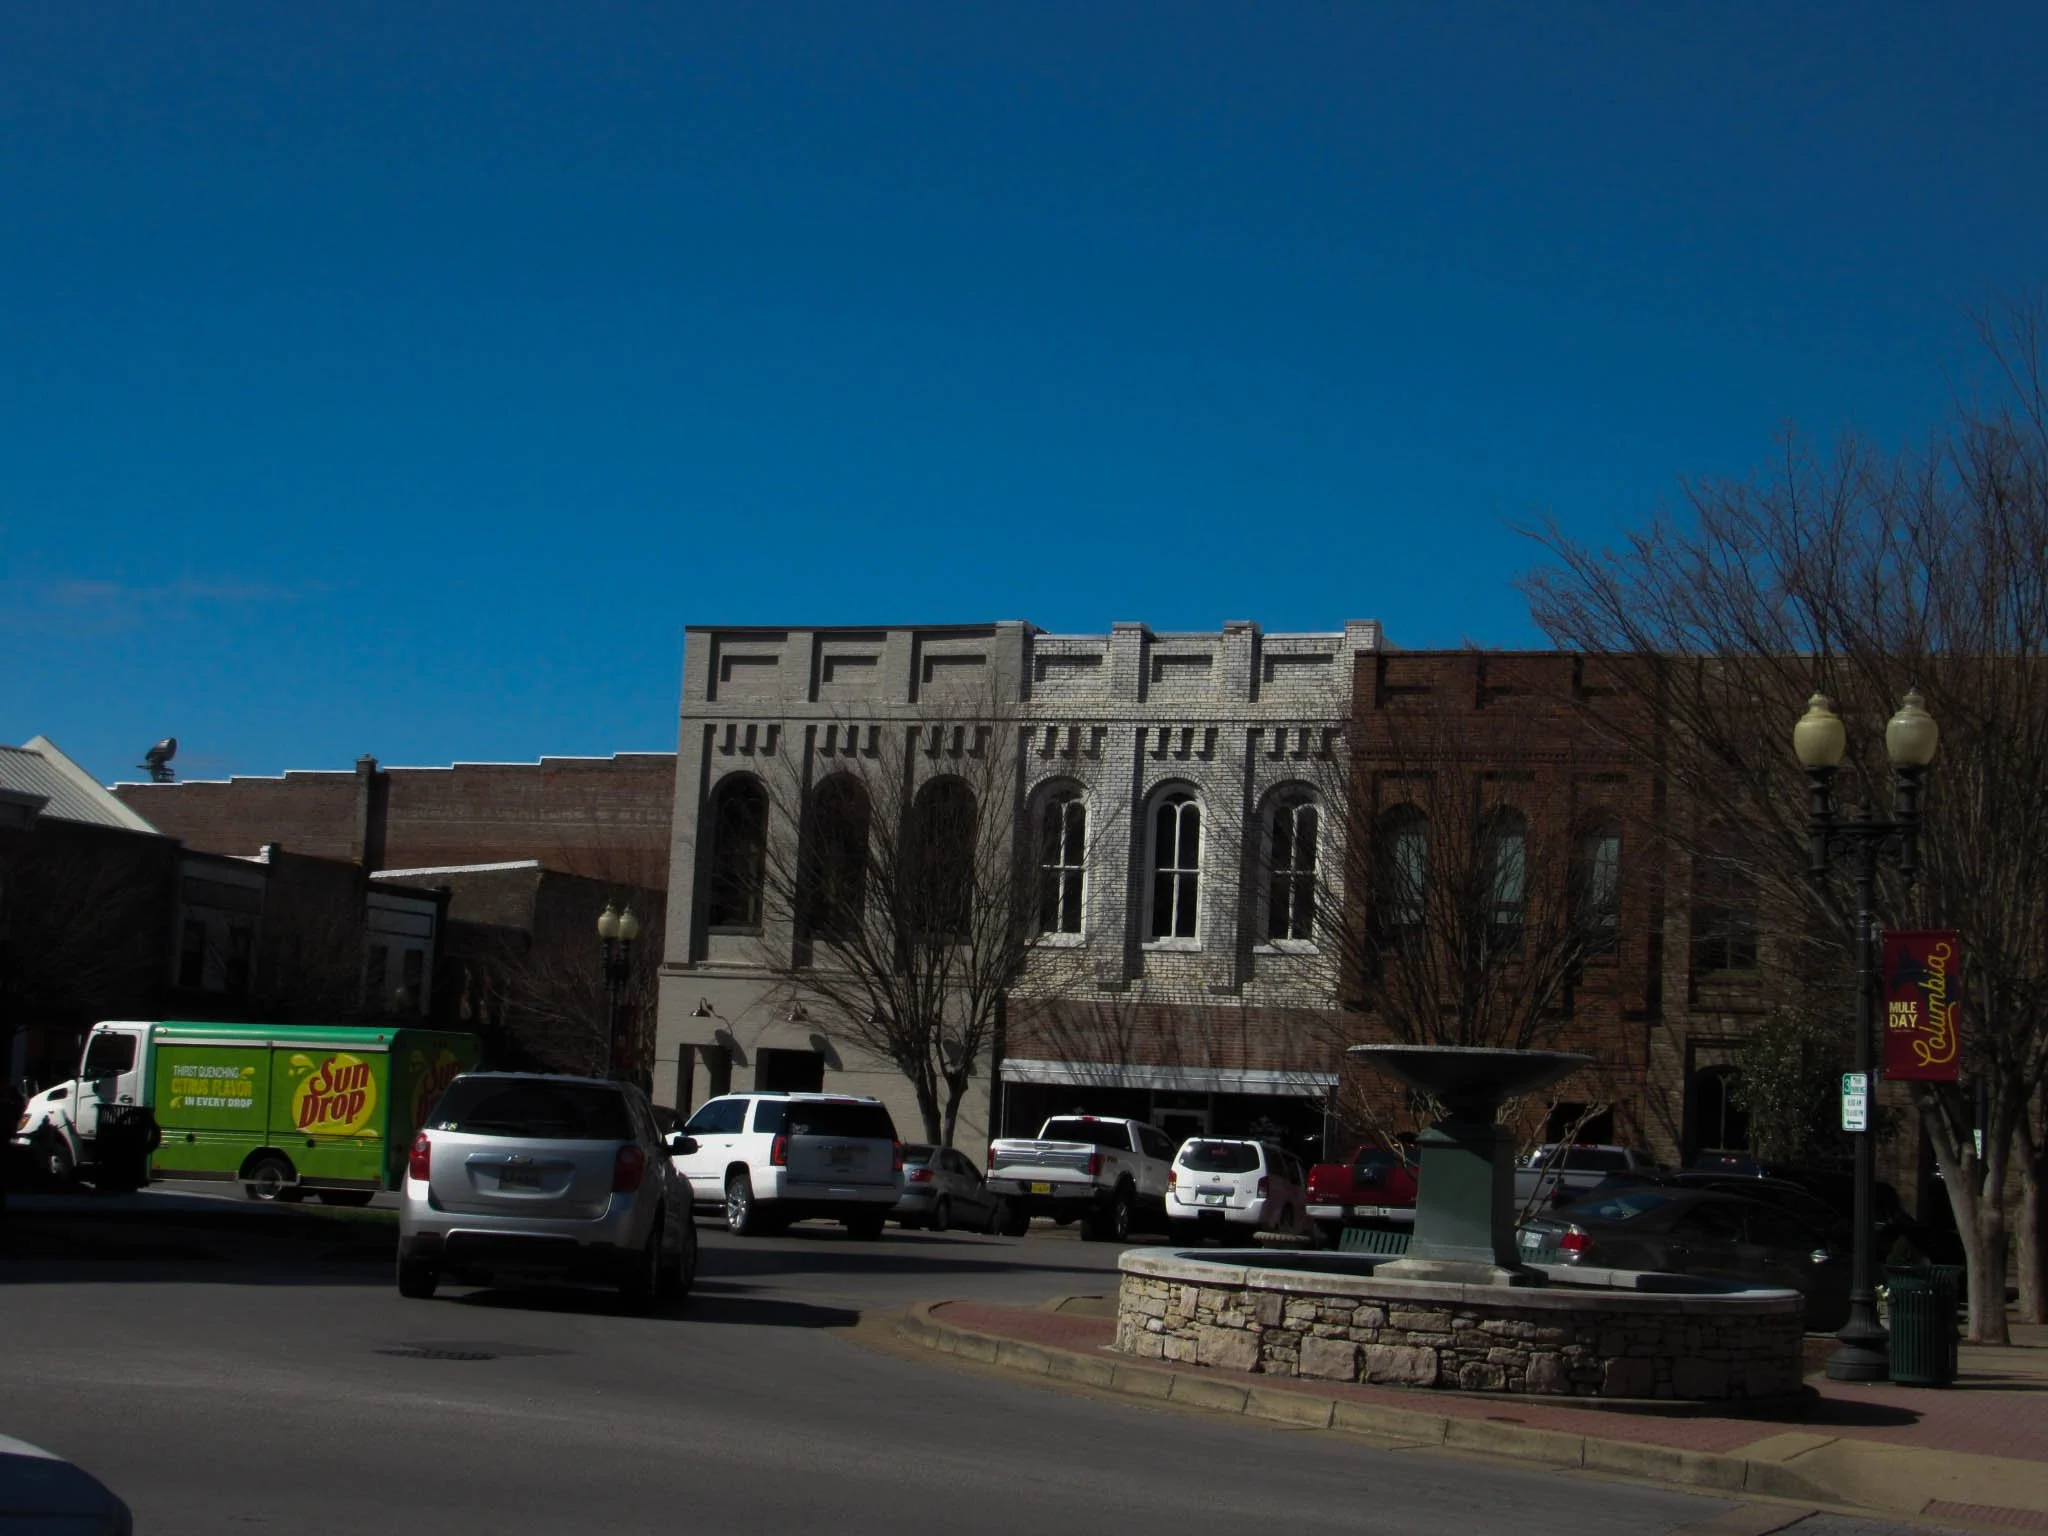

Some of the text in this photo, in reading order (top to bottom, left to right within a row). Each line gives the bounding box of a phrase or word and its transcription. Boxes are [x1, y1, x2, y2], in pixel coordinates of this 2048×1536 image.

[1888, 1001, 1918, 1014] MULE
[1911, 941, 1957, 1068] Columbia
[1888, 1014, 1919, 1029] DAY
[172, 1064, 239, 1079] THIRST QUENCHING
[309, 1057, 370, 1098] Sun
[171, 1077, 253, 1098] CITRUS FLAVOR
[1844, 1078, 1850, 1093] 3
[184, 1096, 253, 1109] IN EVERY DROP
[298, 1089, 366, 1129] Drop
